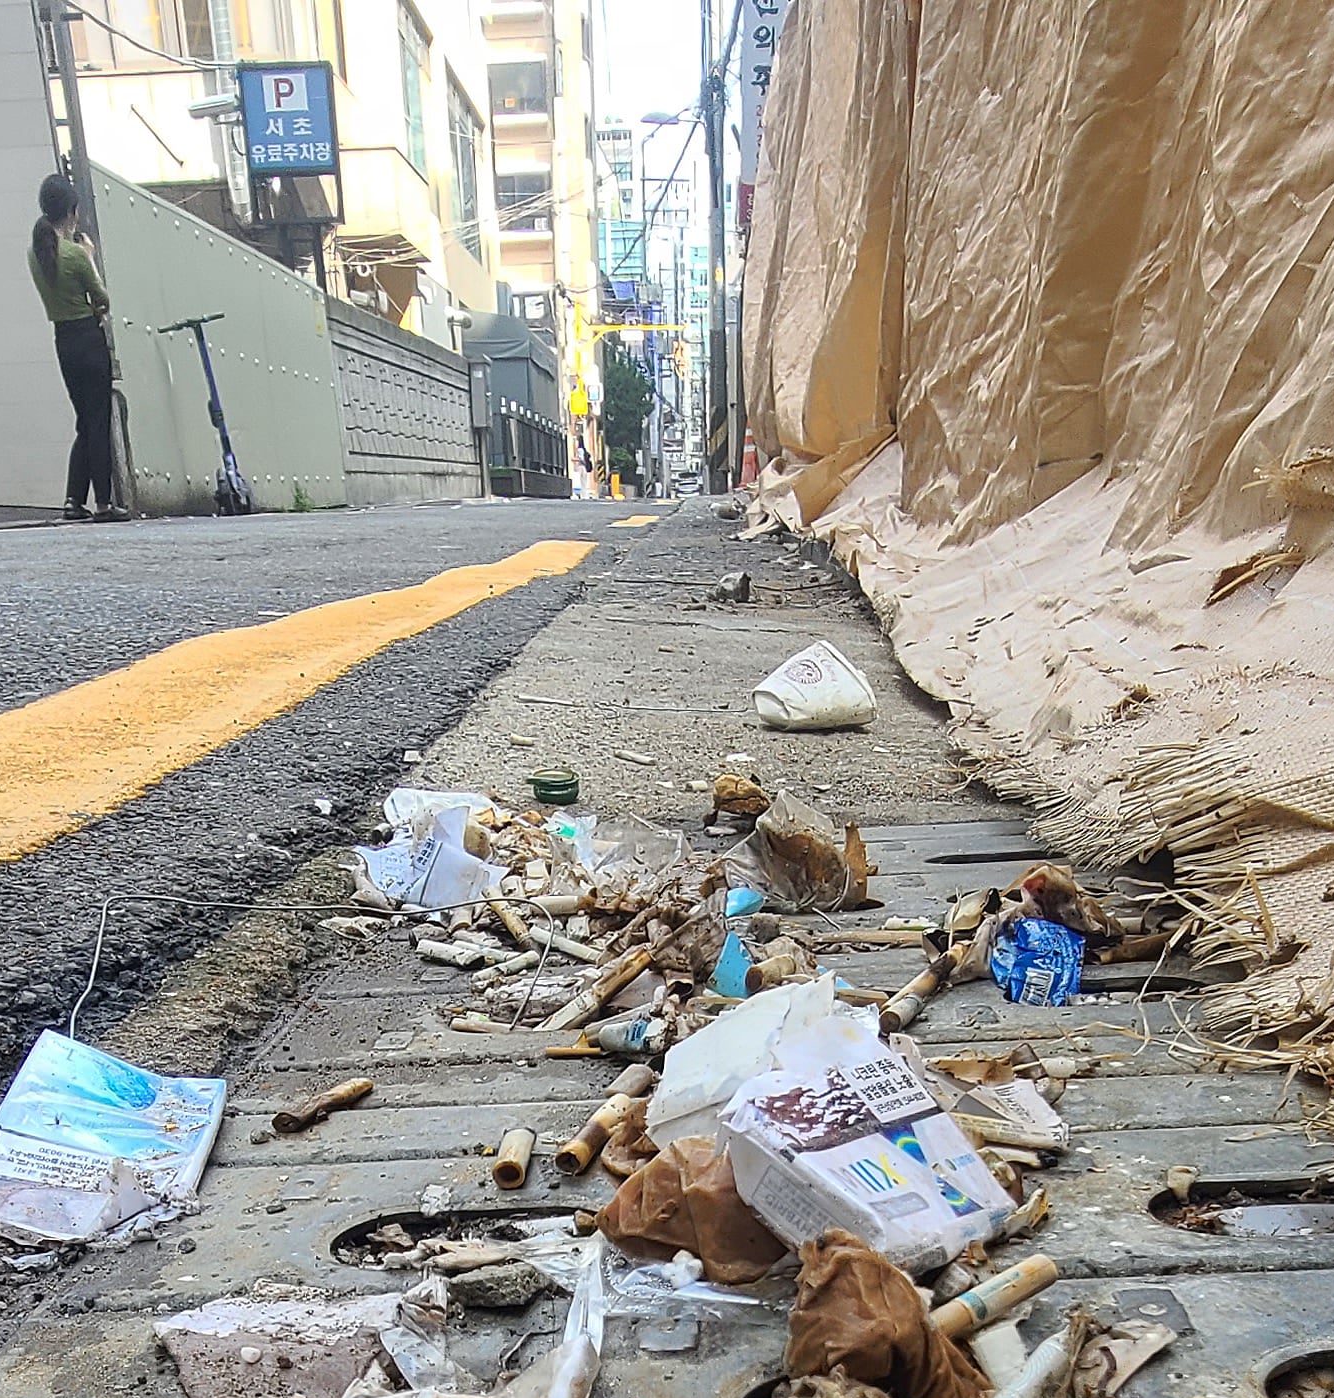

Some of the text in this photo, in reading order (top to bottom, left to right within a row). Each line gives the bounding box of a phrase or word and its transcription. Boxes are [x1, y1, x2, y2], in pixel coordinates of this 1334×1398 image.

[273, 78, 294, 108] P
[251, 142, 331, 163] 유료주차장
[851, 1063, 881, 1080] 니코틴
